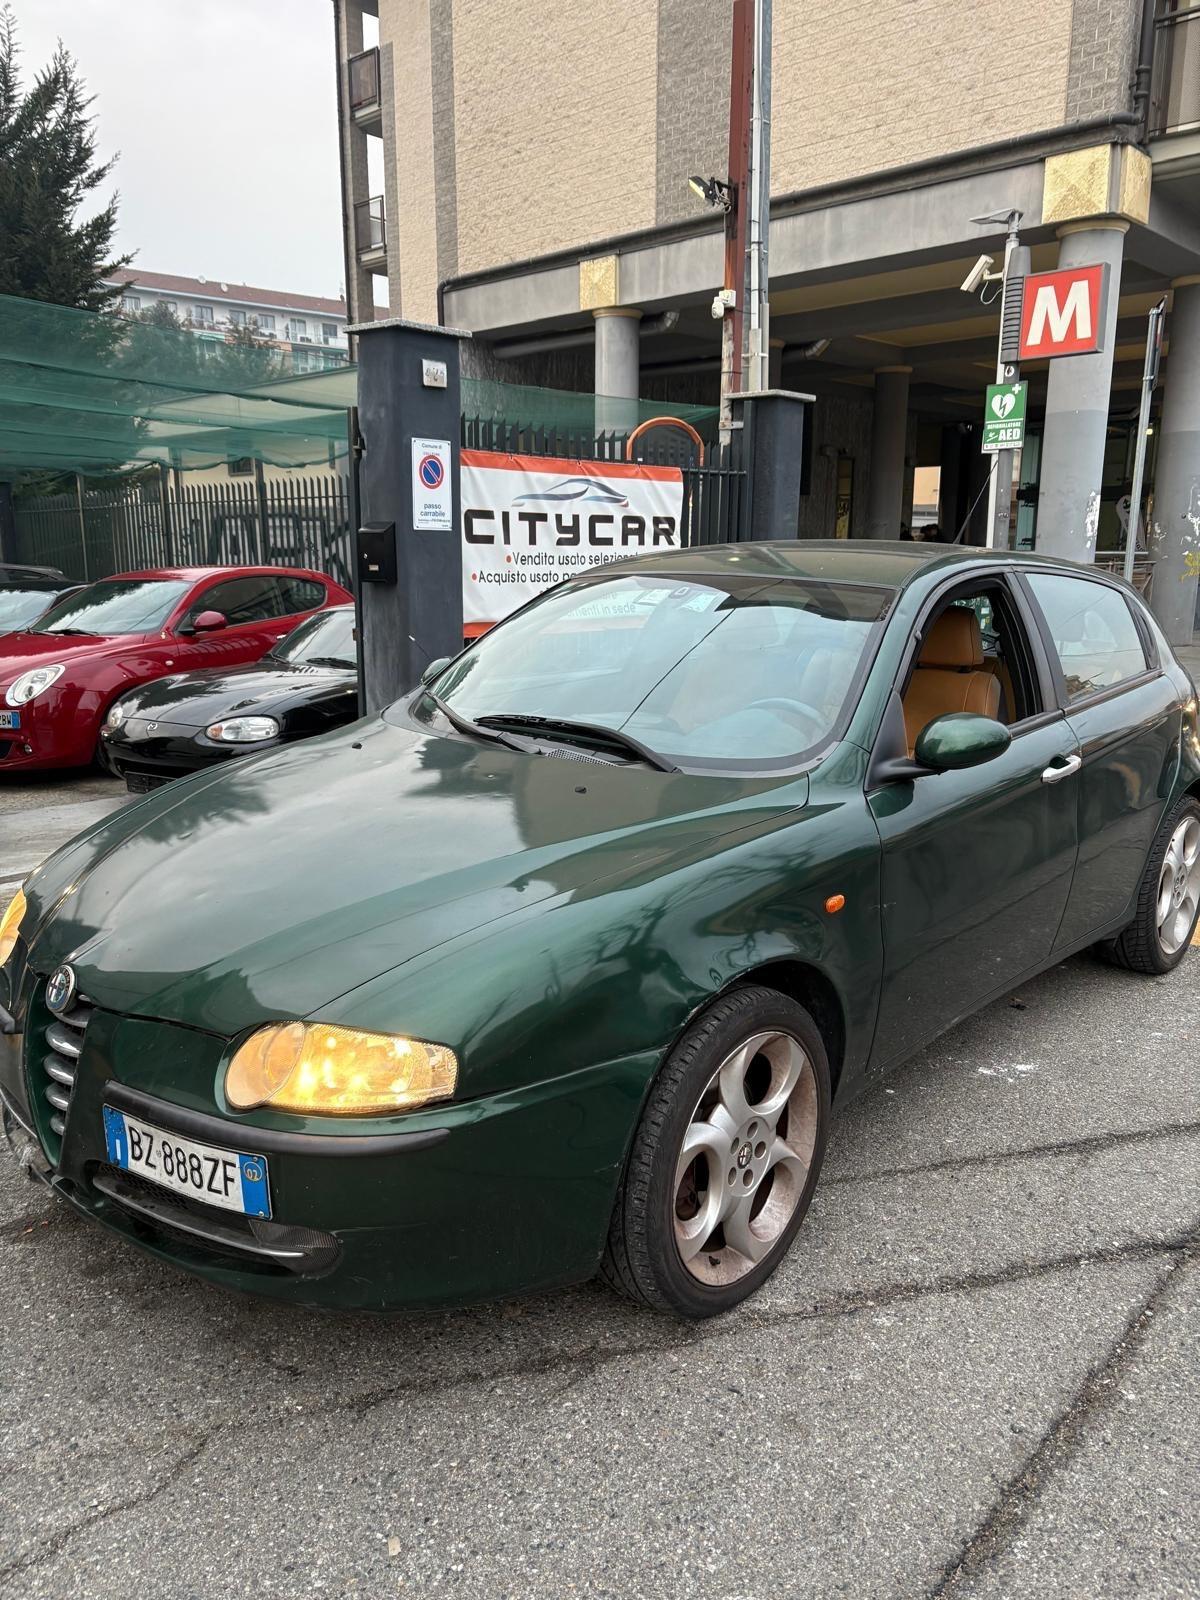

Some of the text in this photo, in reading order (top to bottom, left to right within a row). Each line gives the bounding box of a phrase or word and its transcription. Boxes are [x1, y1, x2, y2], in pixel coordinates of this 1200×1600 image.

[1026, 280, 1092, 346] M
[998, 428, 1021, 441] AED
[463, 508, 676, 547] CITYCAR
[512, 552, 555, 566] Vendita
[558, 553, 586, 566] usato
[478, 570, 526, 586] Acquisto
[529, 571, 560, 583] usato
